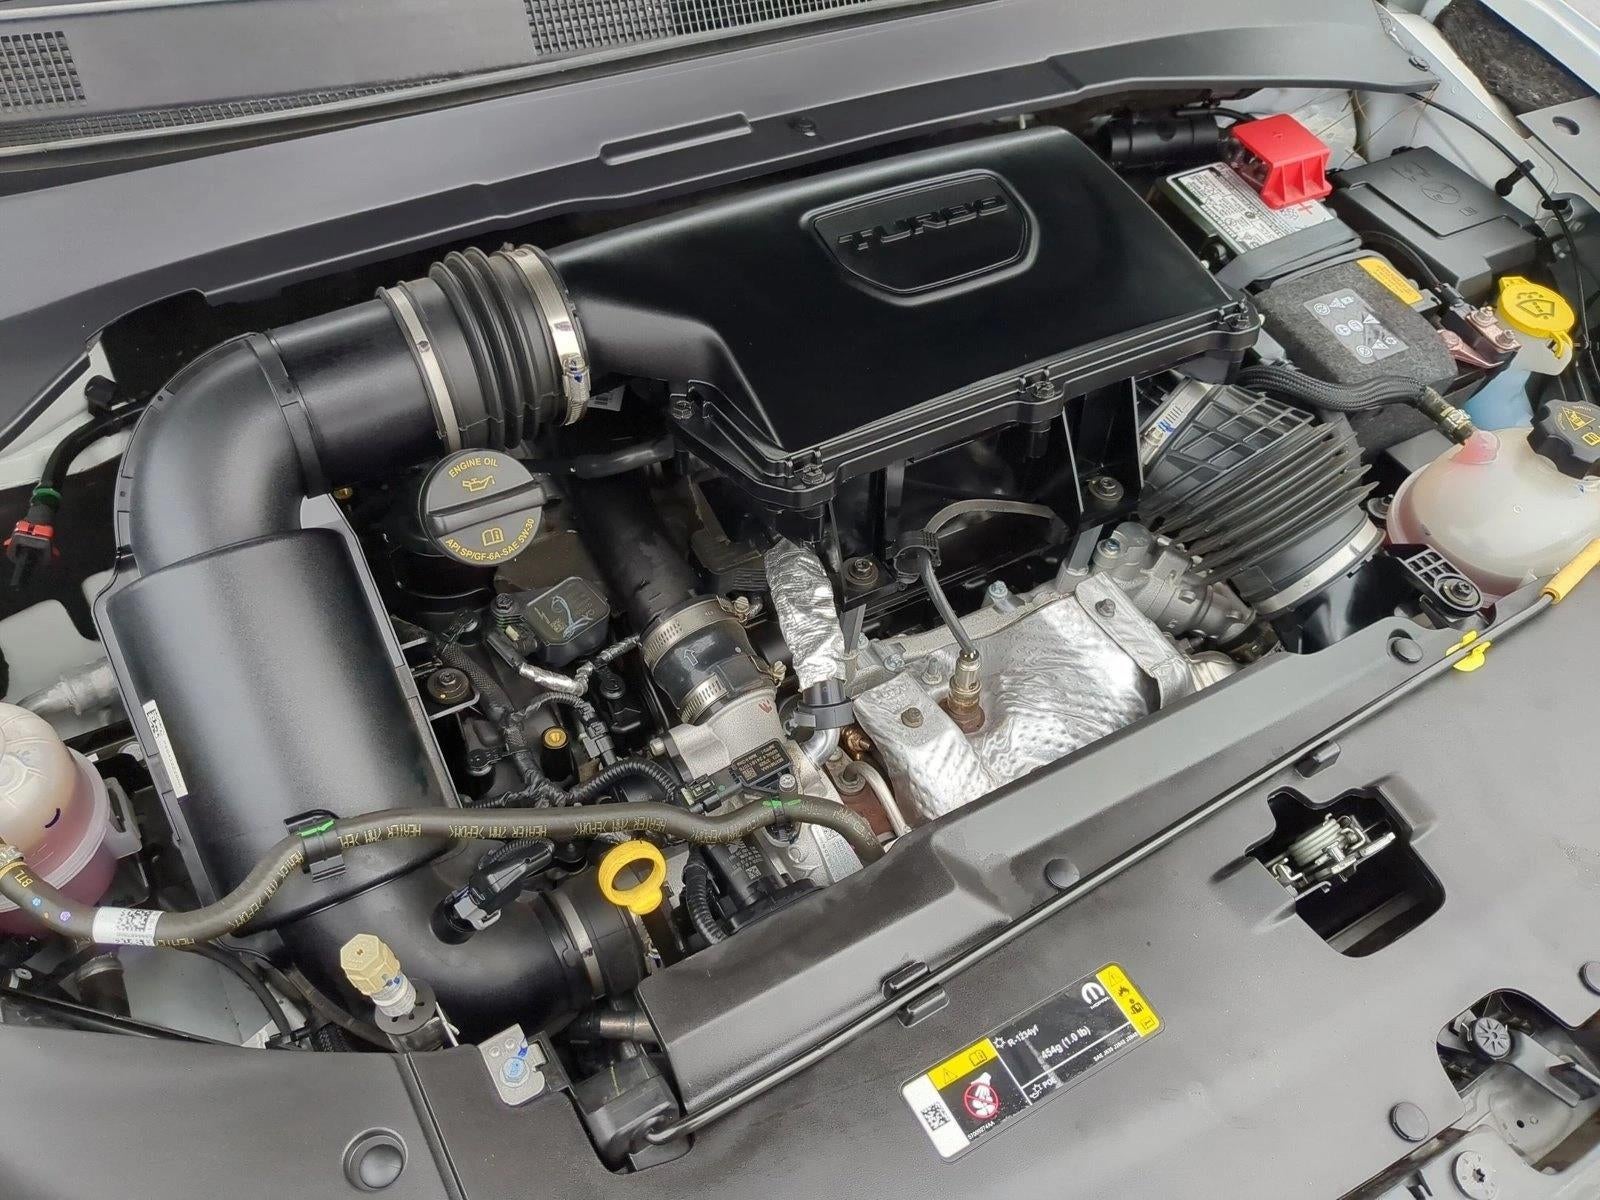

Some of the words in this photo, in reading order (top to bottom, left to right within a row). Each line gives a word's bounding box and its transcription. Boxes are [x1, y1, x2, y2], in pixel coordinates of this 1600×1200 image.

[837, 195, 1008, 250] TURBO
[448, 457, 482, 478] ENGINE
[483, 457, 499, 467] OIL
[445, 538, 461, 553] API
[518, 518, 535, 543] 5W-30
[511, 823, 548, 838] HEATER
[14, 870, 33, 888] BTL
[1006, 1024, 1040, 1047] R-1234yf
[1041, 1043, 1063, 1061] 454g
[1061, 1034, 1078, 1050] (1.0
[1077, 1026, 1091, 1042] lb)
[1042, 1077, 1058, 1089] POE
